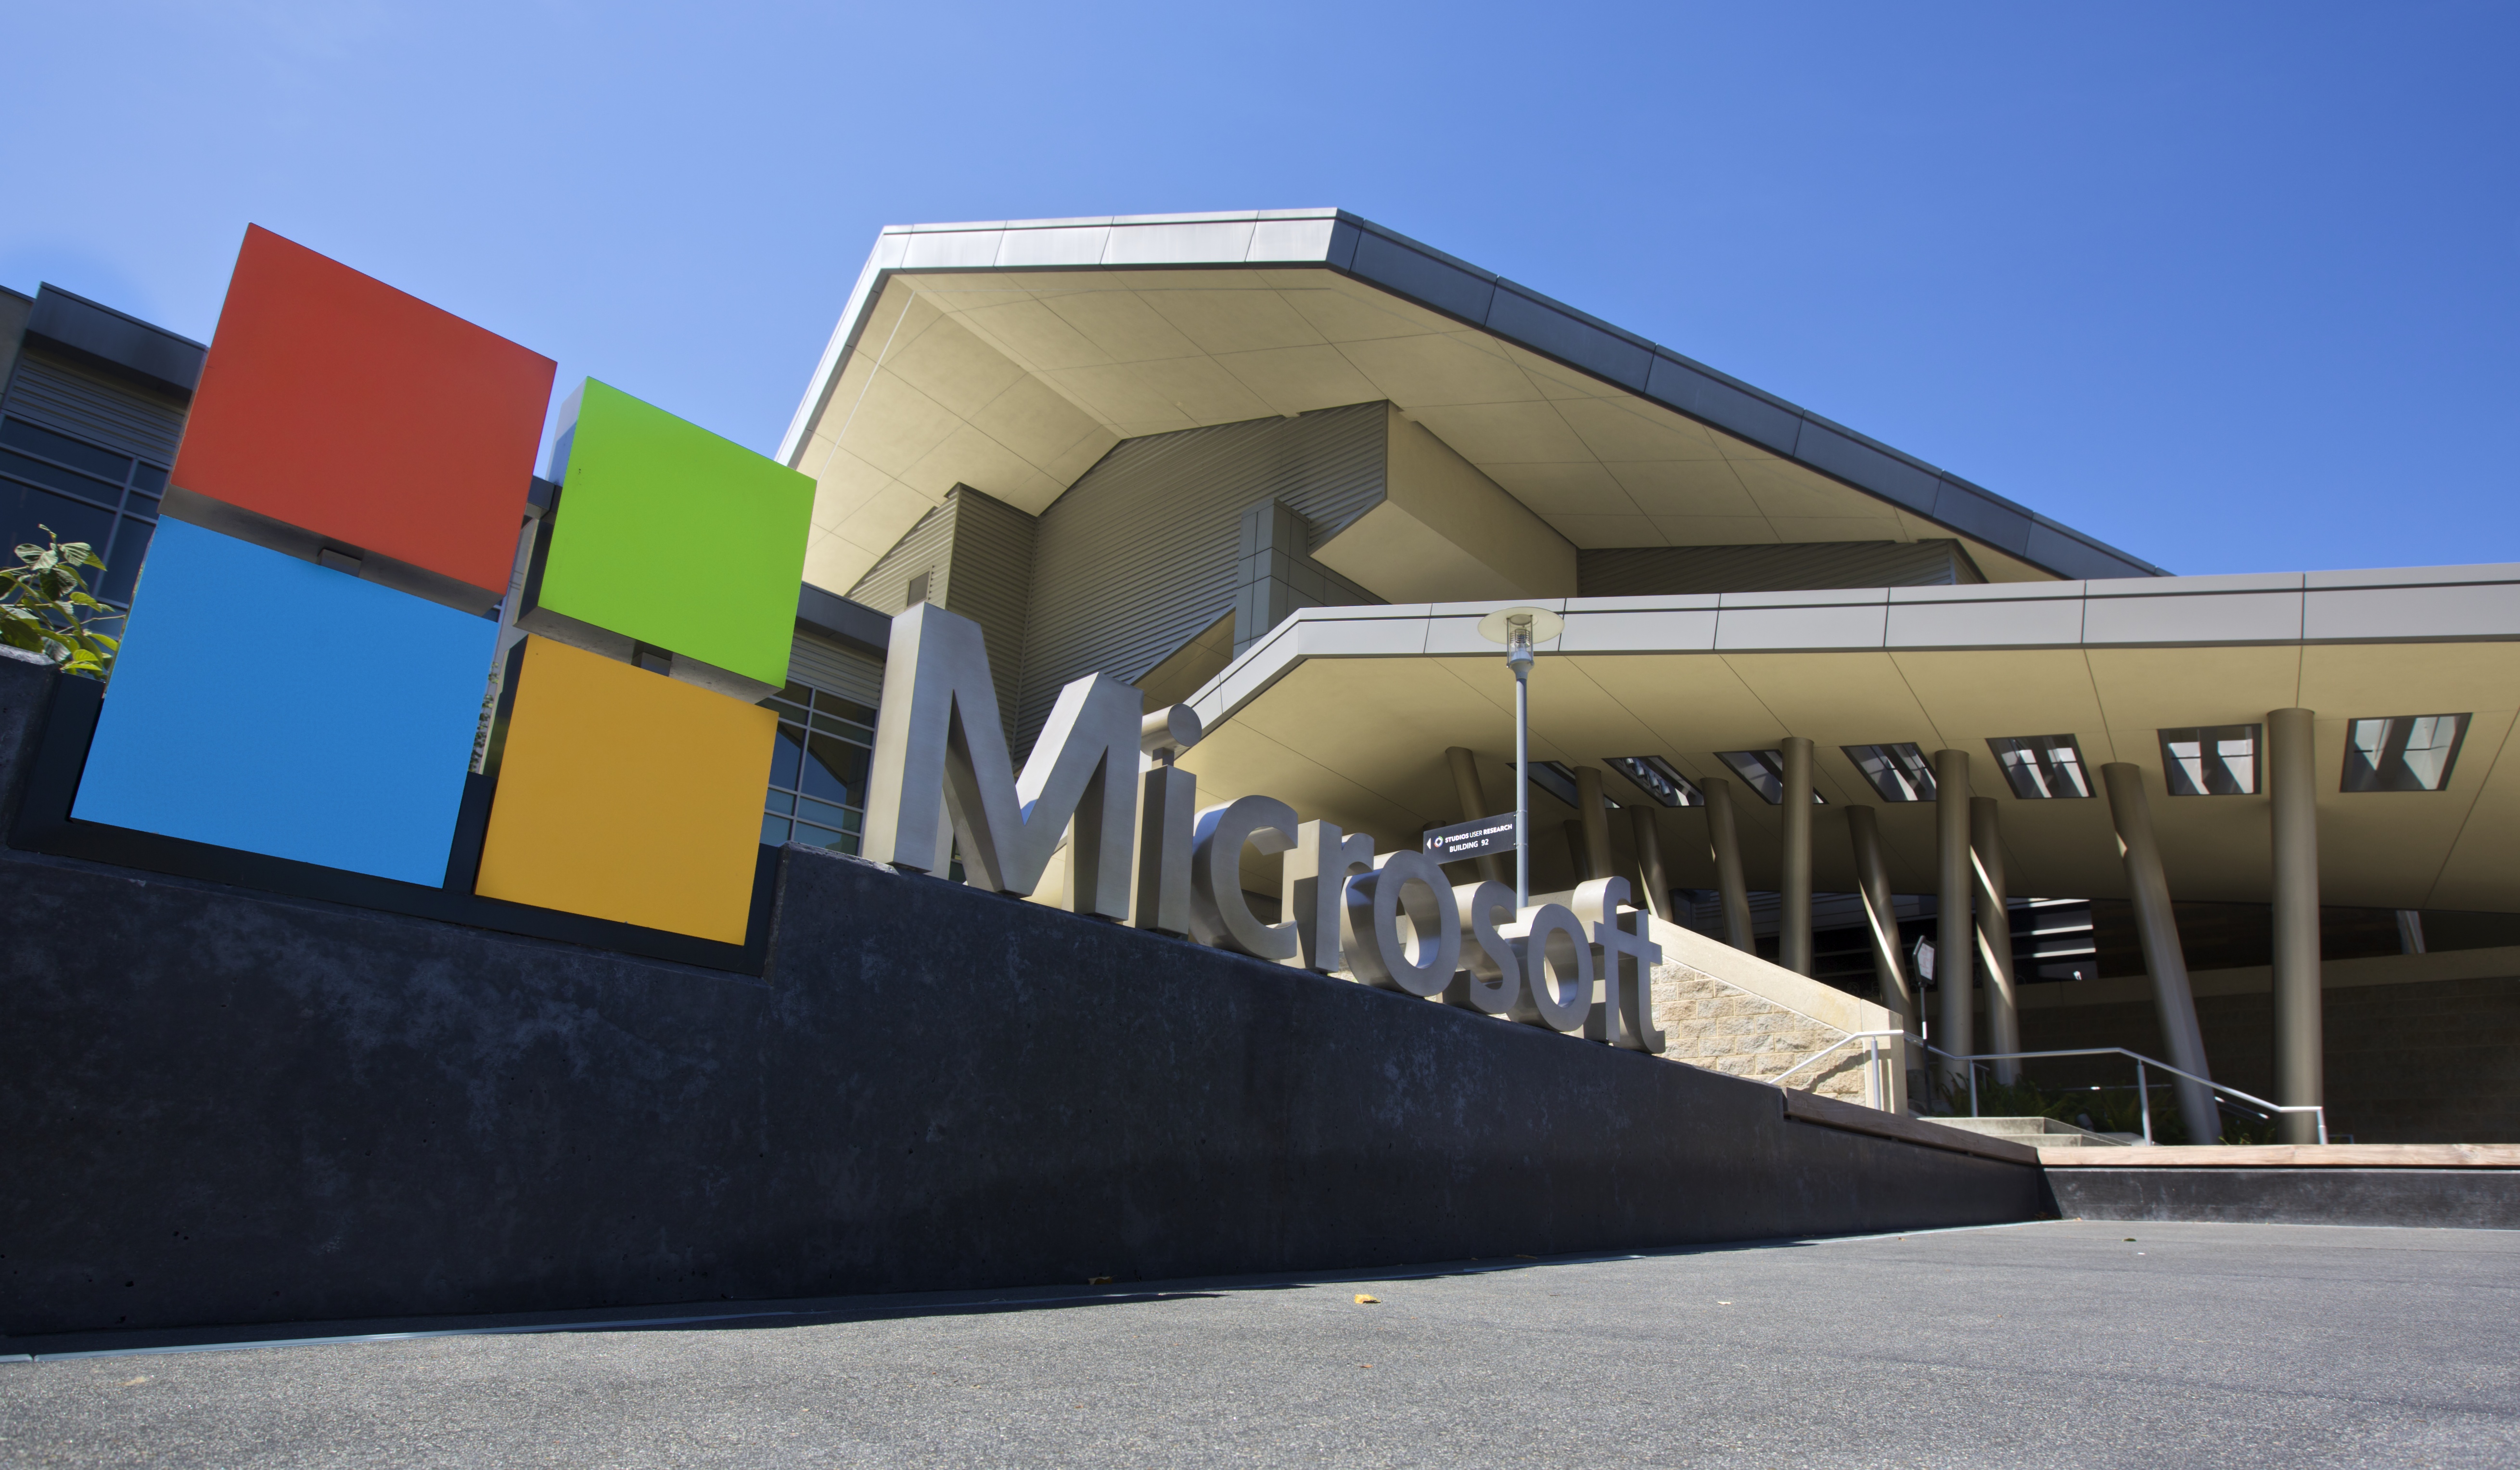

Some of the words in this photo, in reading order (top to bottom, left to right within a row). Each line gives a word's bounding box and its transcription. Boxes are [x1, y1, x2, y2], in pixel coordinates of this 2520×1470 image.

[864, 603, 1665, 1053] Microsoft
[1445, 833, 1469, 843] STUDIOS
[1470, 830, 1482, 838] USER
[1484, 824, 1512, 835] RESEARCH
[1449, 840, 1478, 852] BUILDING
